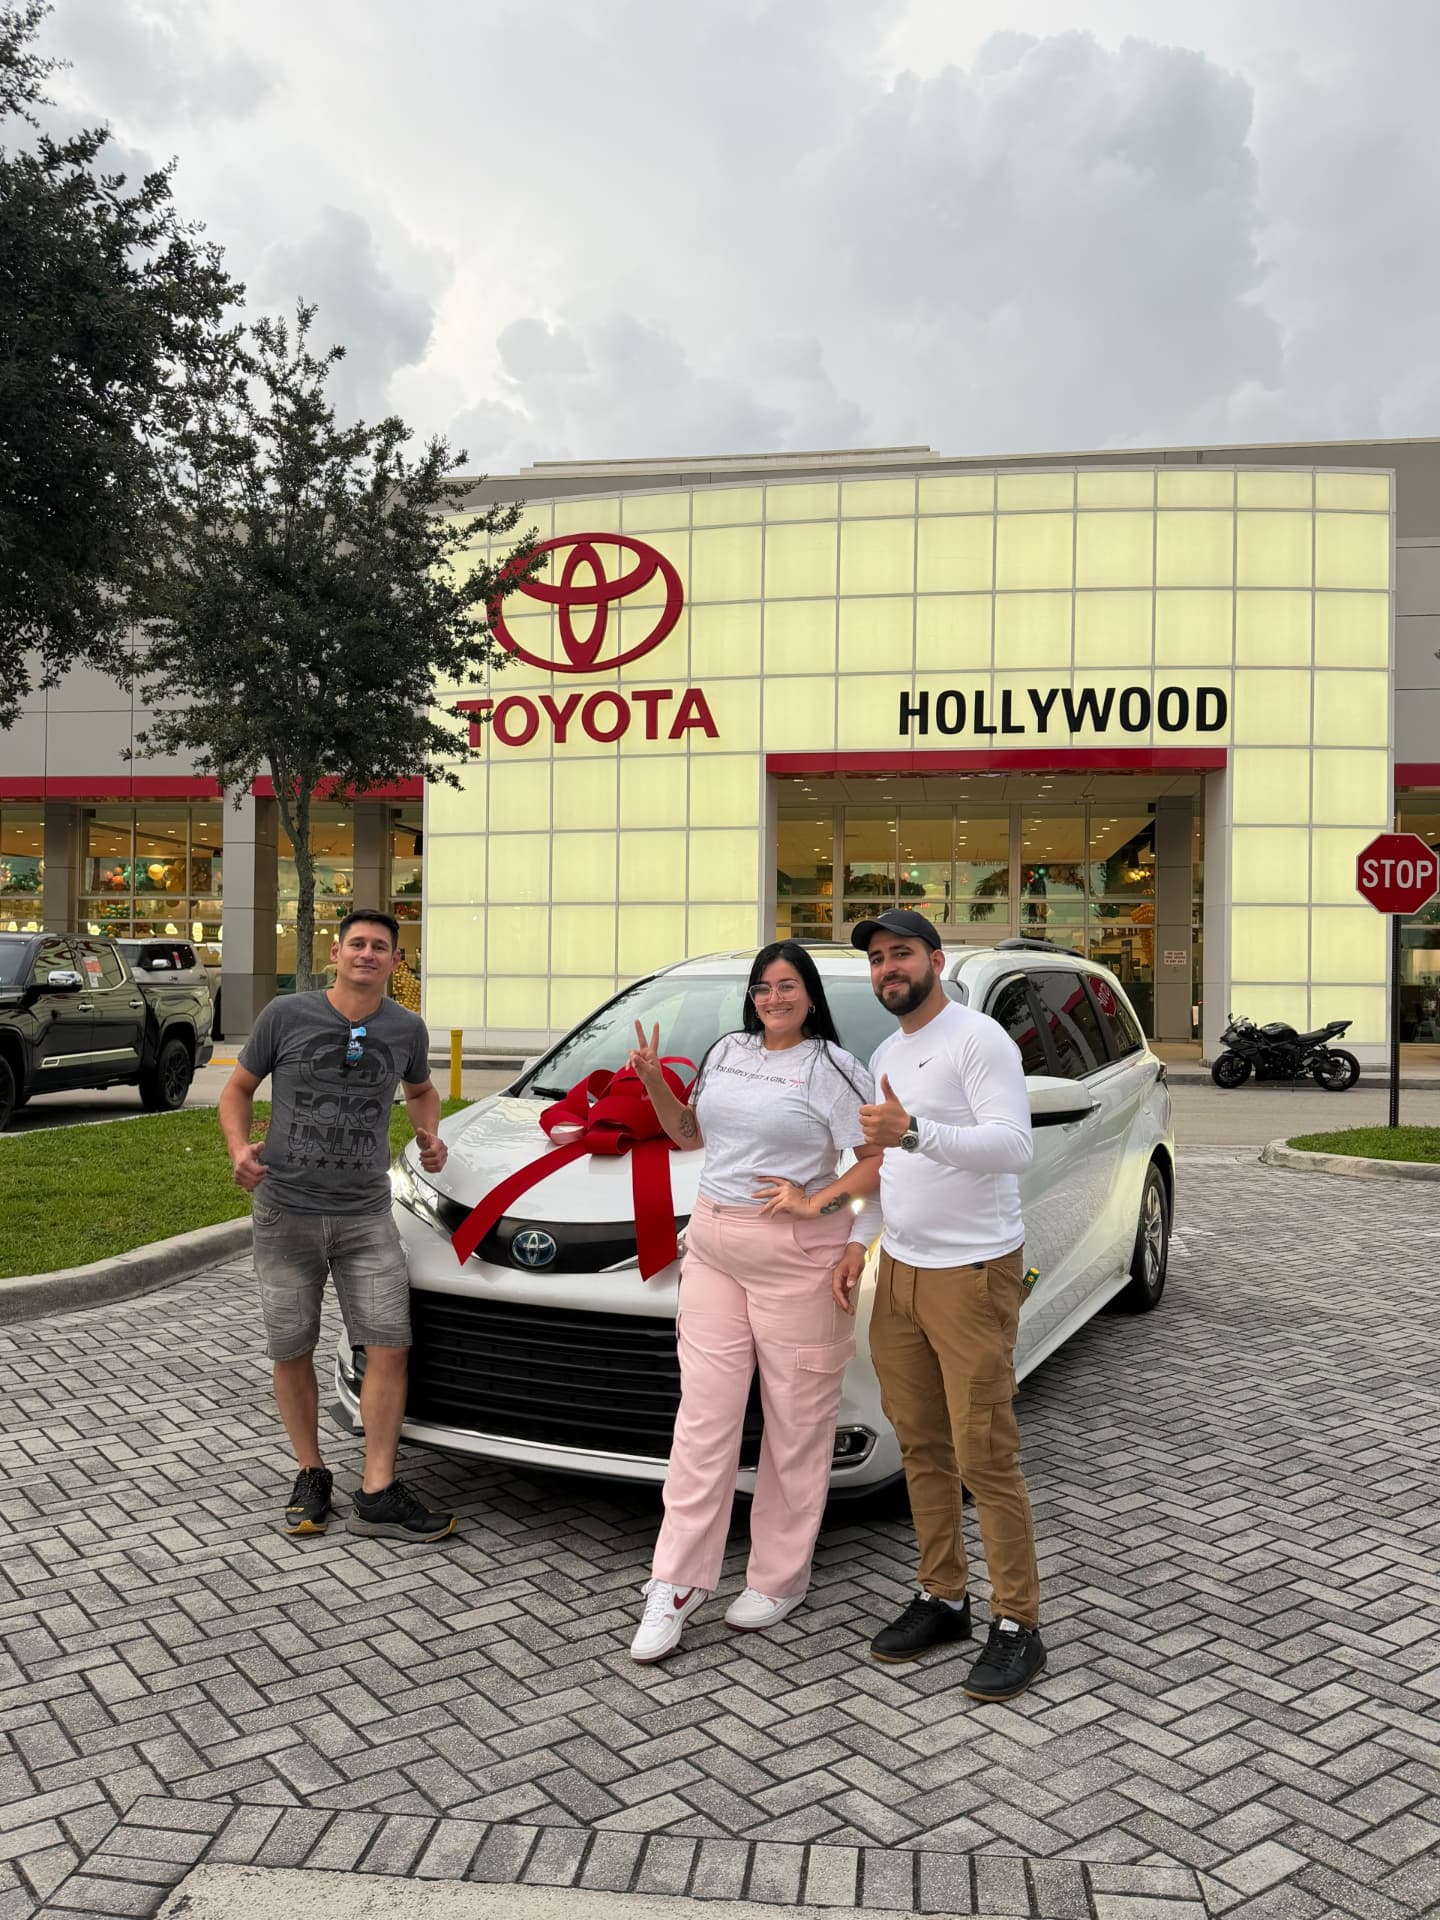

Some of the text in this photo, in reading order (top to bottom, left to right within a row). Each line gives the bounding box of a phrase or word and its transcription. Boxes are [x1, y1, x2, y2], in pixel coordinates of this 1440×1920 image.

[456, 688, 720, 748] TOYOTA
[899, 686, 1228, 735] HOLLYWOOD
[1362, 858, 1433, 889] STOP
[294, 1091, 382, 1130] ECKO
[288, 1123, 377, 1157] UNLTD
